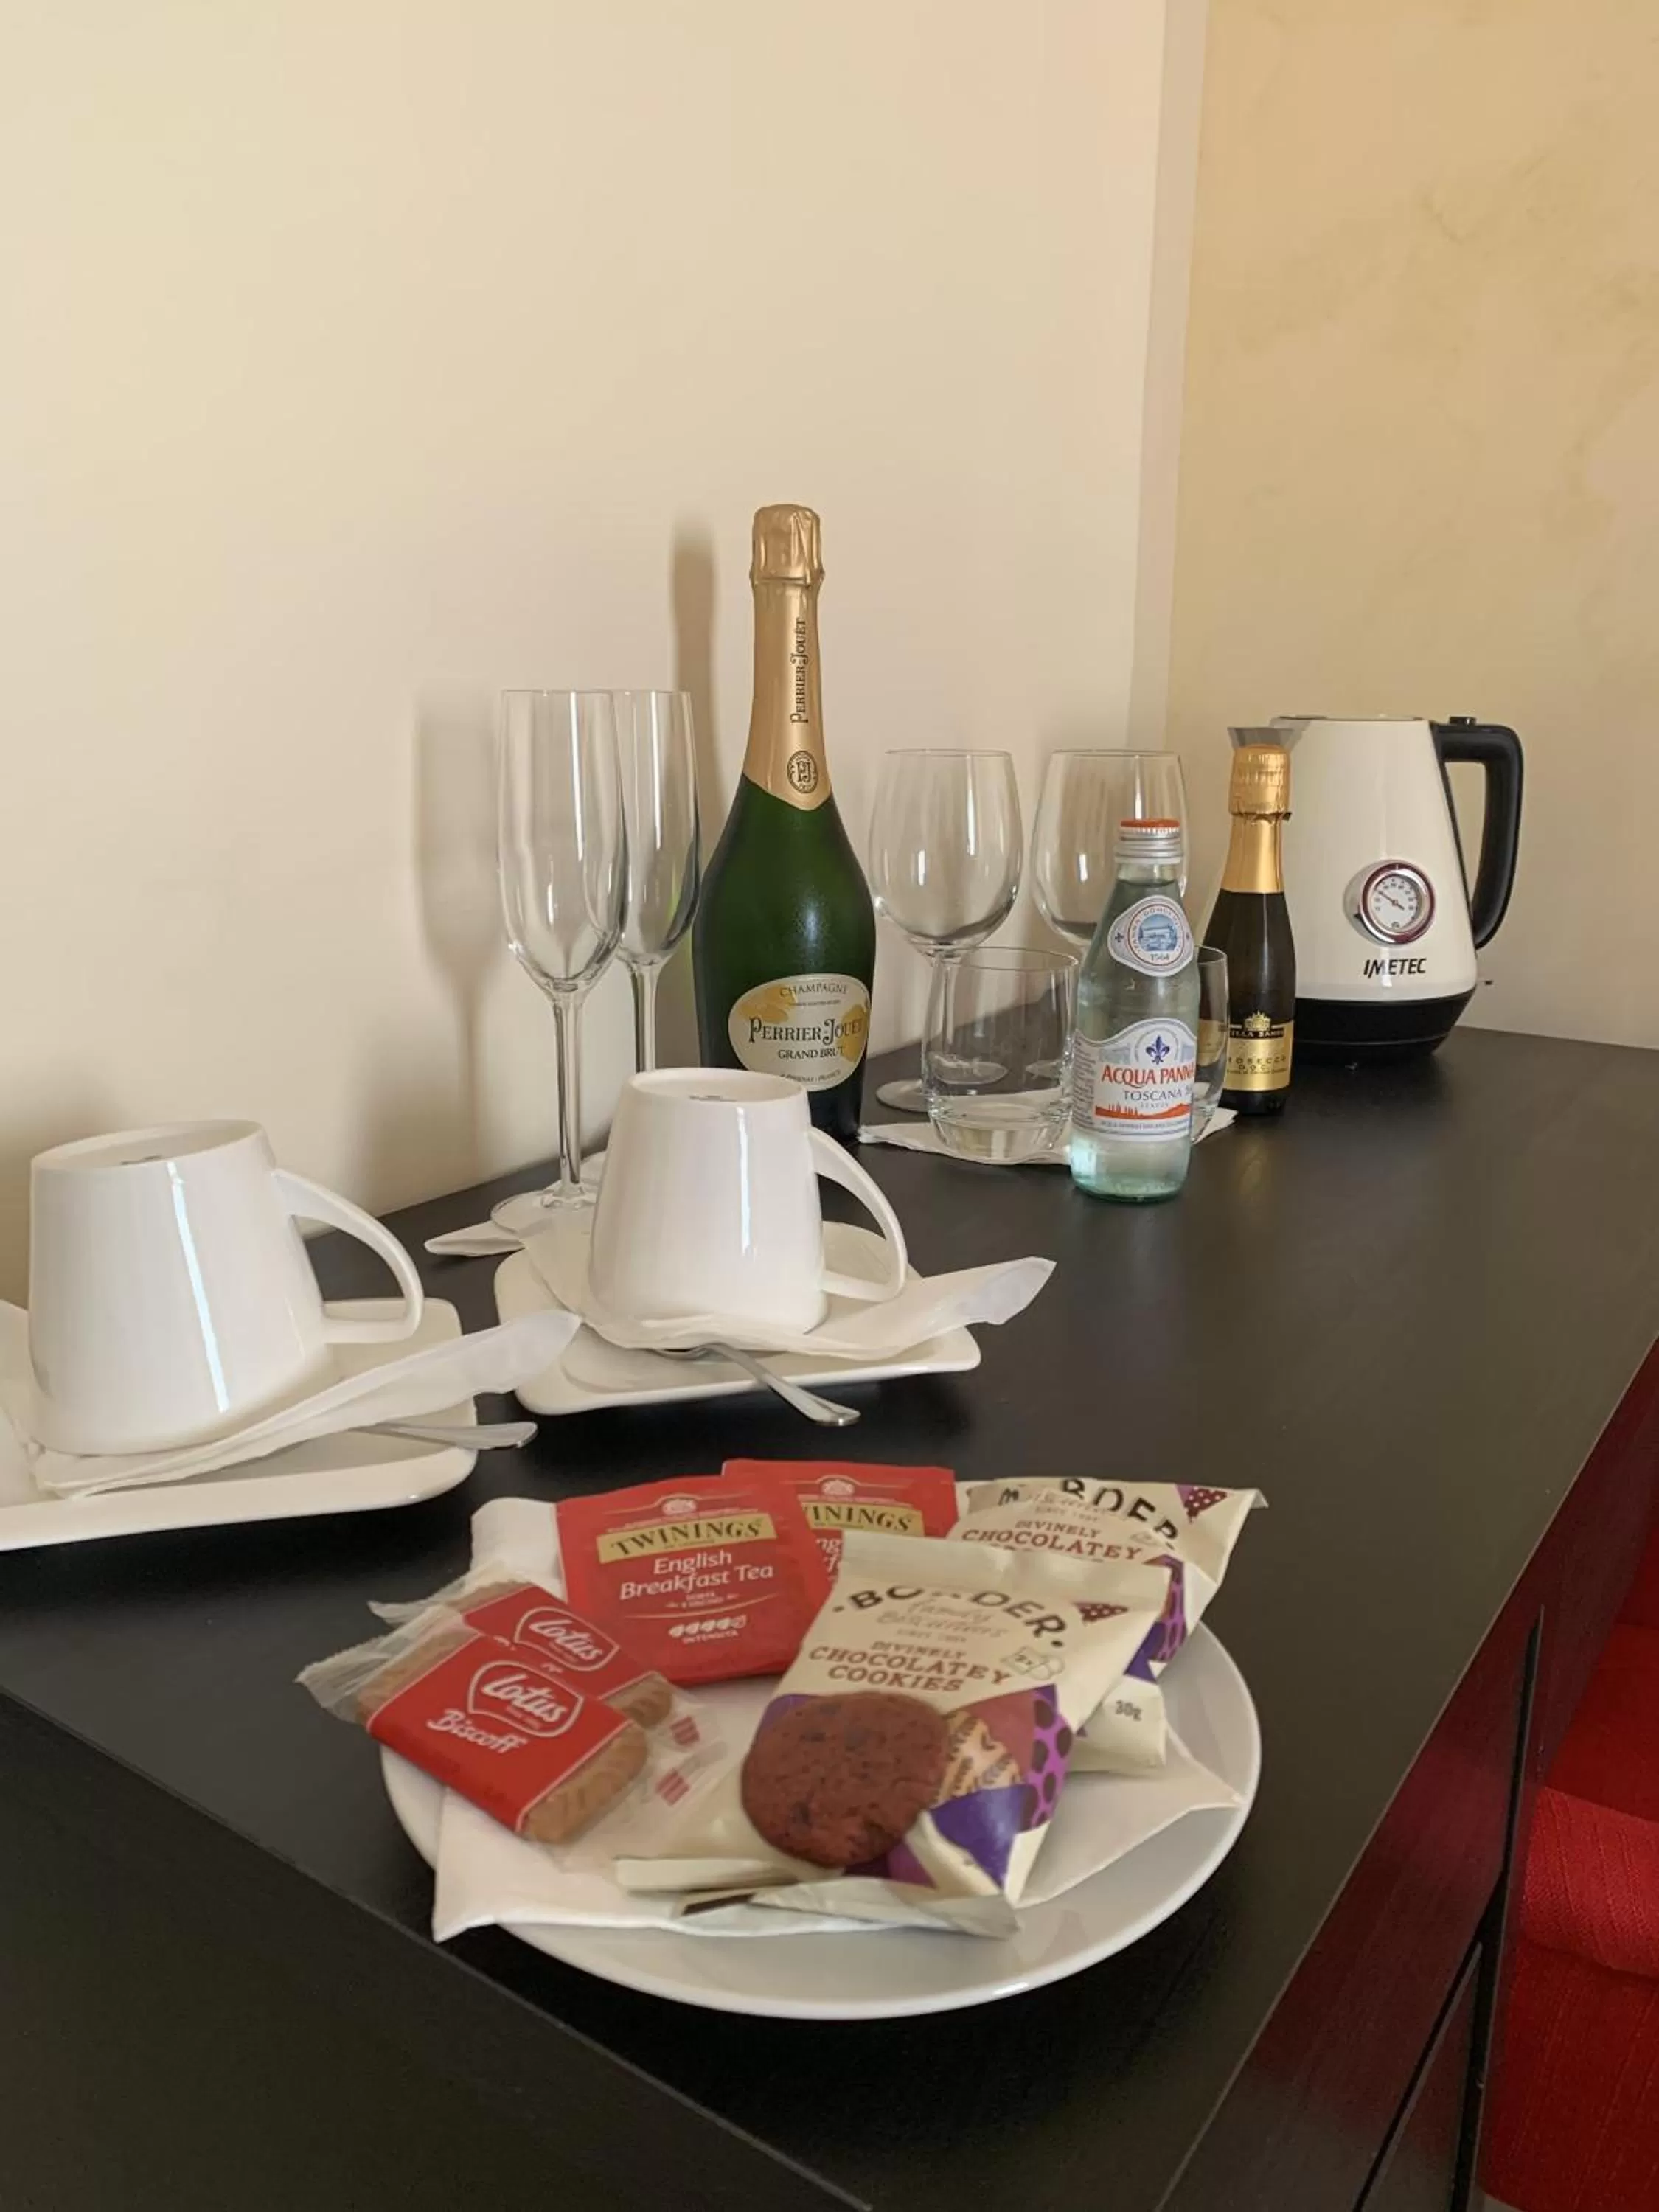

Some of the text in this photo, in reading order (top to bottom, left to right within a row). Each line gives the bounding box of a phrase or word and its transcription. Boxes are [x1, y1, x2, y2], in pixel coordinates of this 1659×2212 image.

[1363, 958, 1427, 978] IMETEC
[779, 983, 848, 998] CHAMPAGNE
[778, 1046, 844, 1060] GRAND BRUT
[1101, 1065, 1156, 1088] ACQUA
[1122, 1088, 1182, 1101] TOSCANA
[804, 1505, 912, 1531] ININGS
[611, 1517, 764, 1556] TWININGS
[961, 1528, 1142, 1560] CHOCOLATEY
[653, 1549, 733, 1576] English
[619, 1569, 730, 1600] Breakfast
[734, 1564, 773, 1582] Tea
[528, 1618, 602, 1661] Lotus
[808, 1645, 1012, 1686] CHOCOLATEY
[827, 1664, 964, 1692] COOKIES
[480, 1672, 568, 1722] Lotus
[1115, 1699, 1143, 1722] 30g
[425, 1707, 529, 1754] Biscoff
